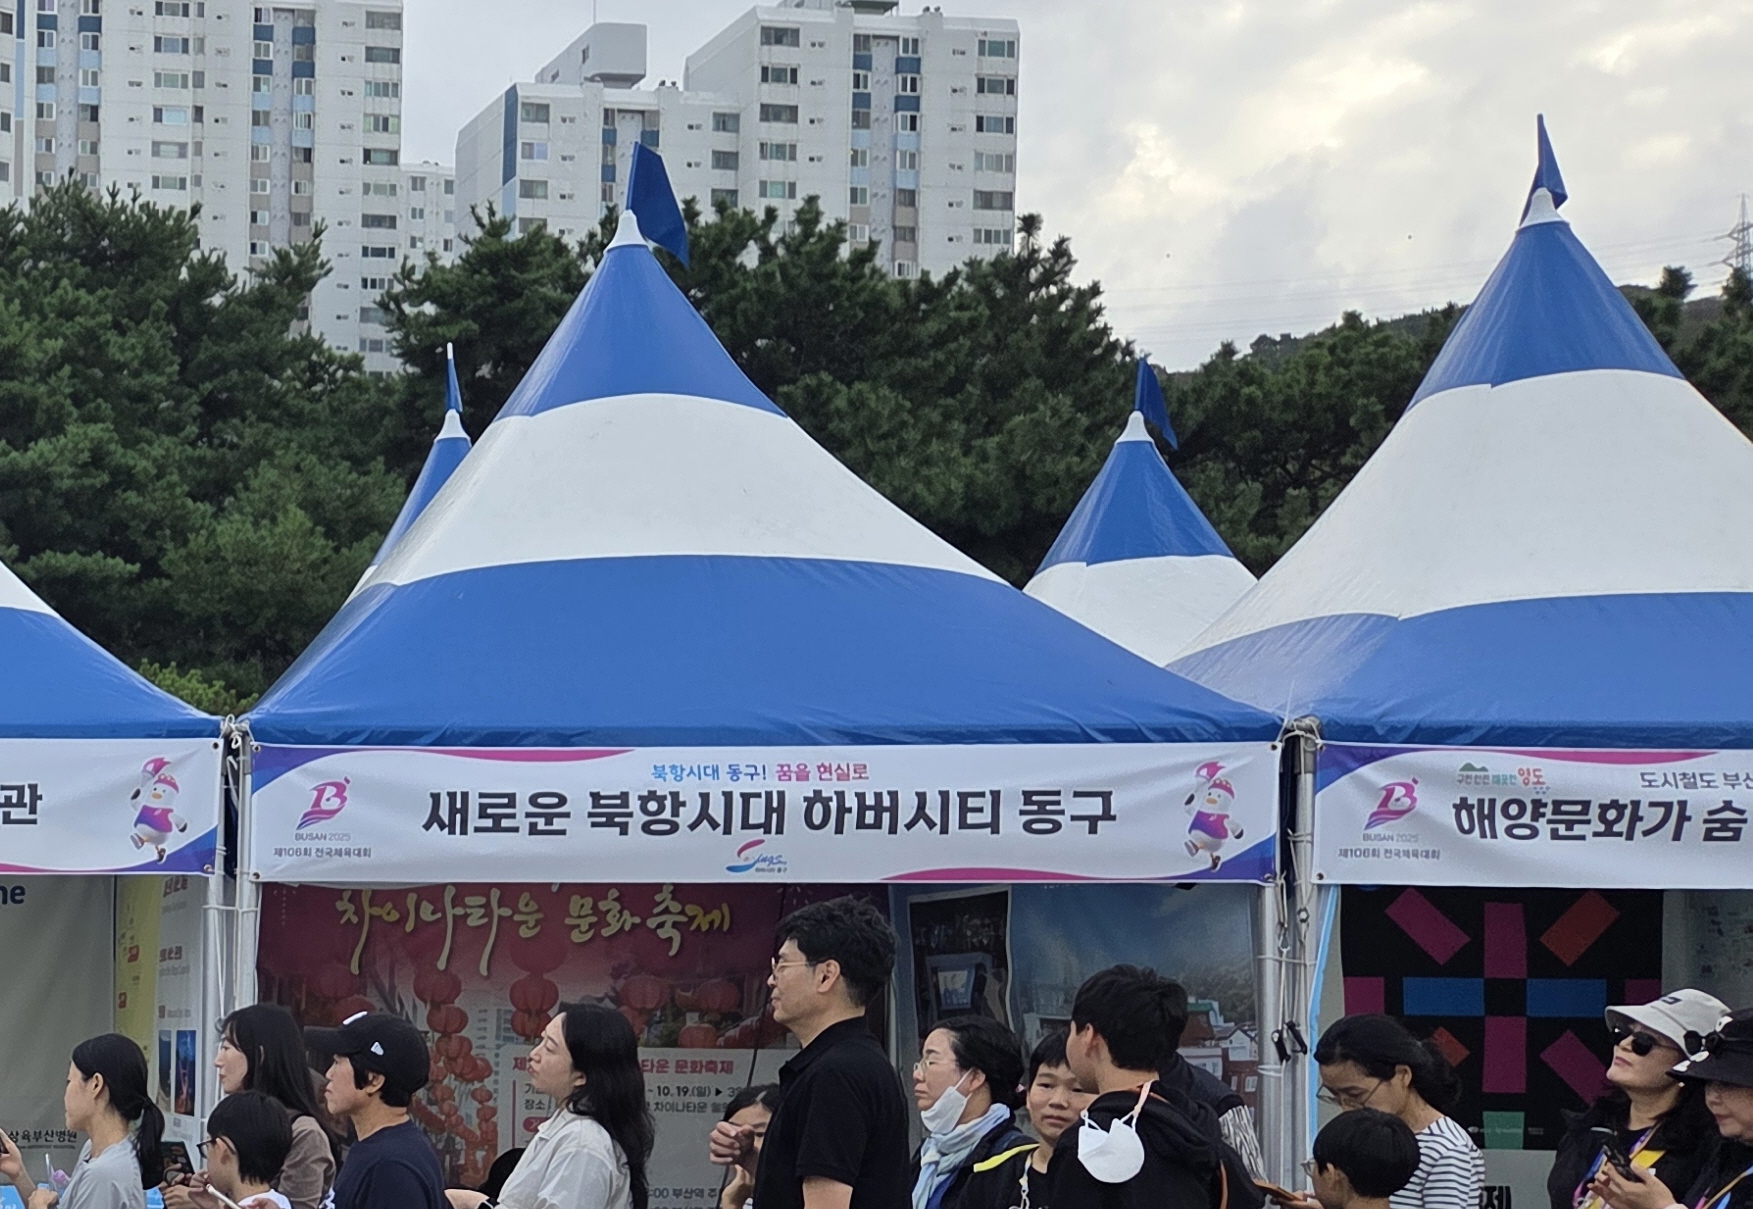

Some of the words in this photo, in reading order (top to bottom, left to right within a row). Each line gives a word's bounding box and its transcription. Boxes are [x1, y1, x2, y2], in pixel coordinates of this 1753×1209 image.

[651, 764, 720, 782] 북항시대
[726, 763, 767, 782] 동구!
[775, 763, 811, 782] 꿈을
[816, 762, 870, 781] 현실로
[1639, 771, 1720, 789] 도시철도
[422, 790, 572, 837] 새로운
[587, 790, 786, 837] 북항시대
[803, 789, 1001, 836] 하버시티
[1018, 789, 1117, 836] 동구
[1452, 796, 1691, 842] 해양문화가
[1702, 800, 1748, 842] 숨
[295, 833, 327, 841] BUSAN
[335, 885, 544, 976] 차이나타운
[524, 1099, 546, 1111] 장소
[654, 1102, 707, 1113] 차이나타운
[673, 1187, 705, 1199] 부산역
